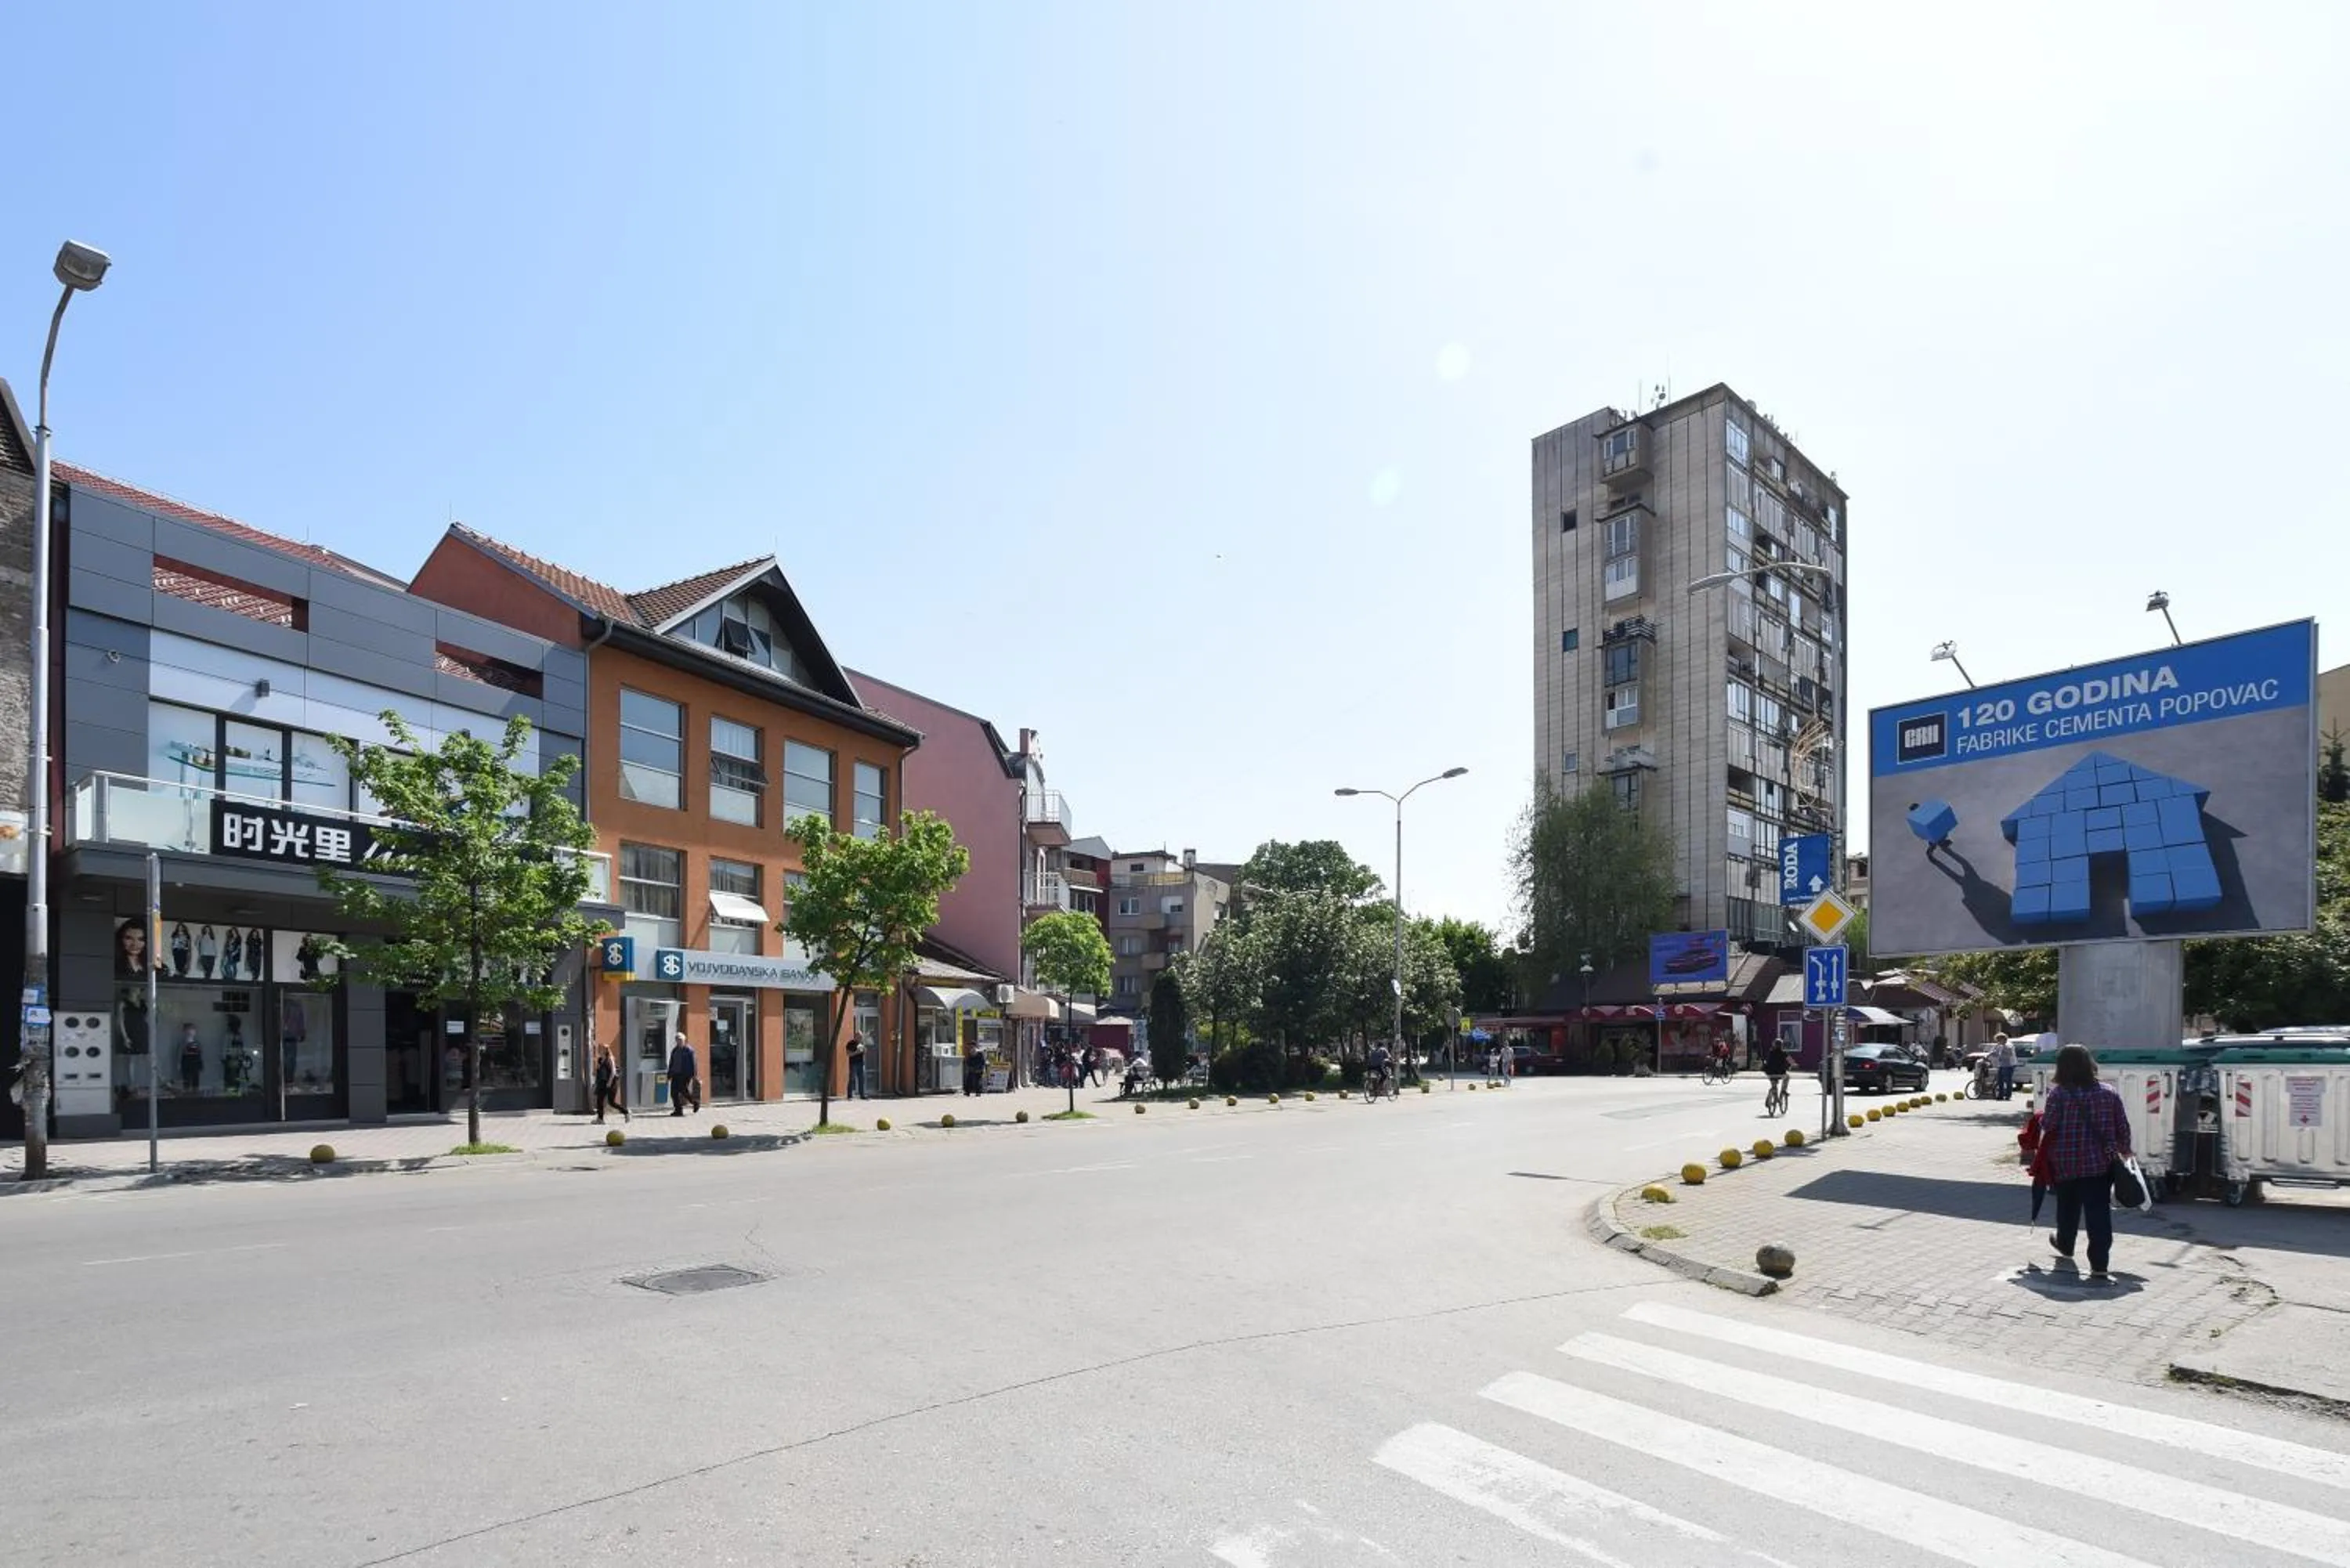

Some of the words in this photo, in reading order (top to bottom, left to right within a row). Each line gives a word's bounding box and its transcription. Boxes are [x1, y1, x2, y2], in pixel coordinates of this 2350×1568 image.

[1957, 723, 2038, 755] FABRIKE
[2045, 703, 2153, 739] CEMENTA
[2160, 679, 2279, 718] POPOVAC
[1958, 699, 2016, 728] 120
[2028, 665, 2178, 715] GODINA
[223, 813, 352, 862] 时光里
[1784, 841, 1798, 889] RODA
